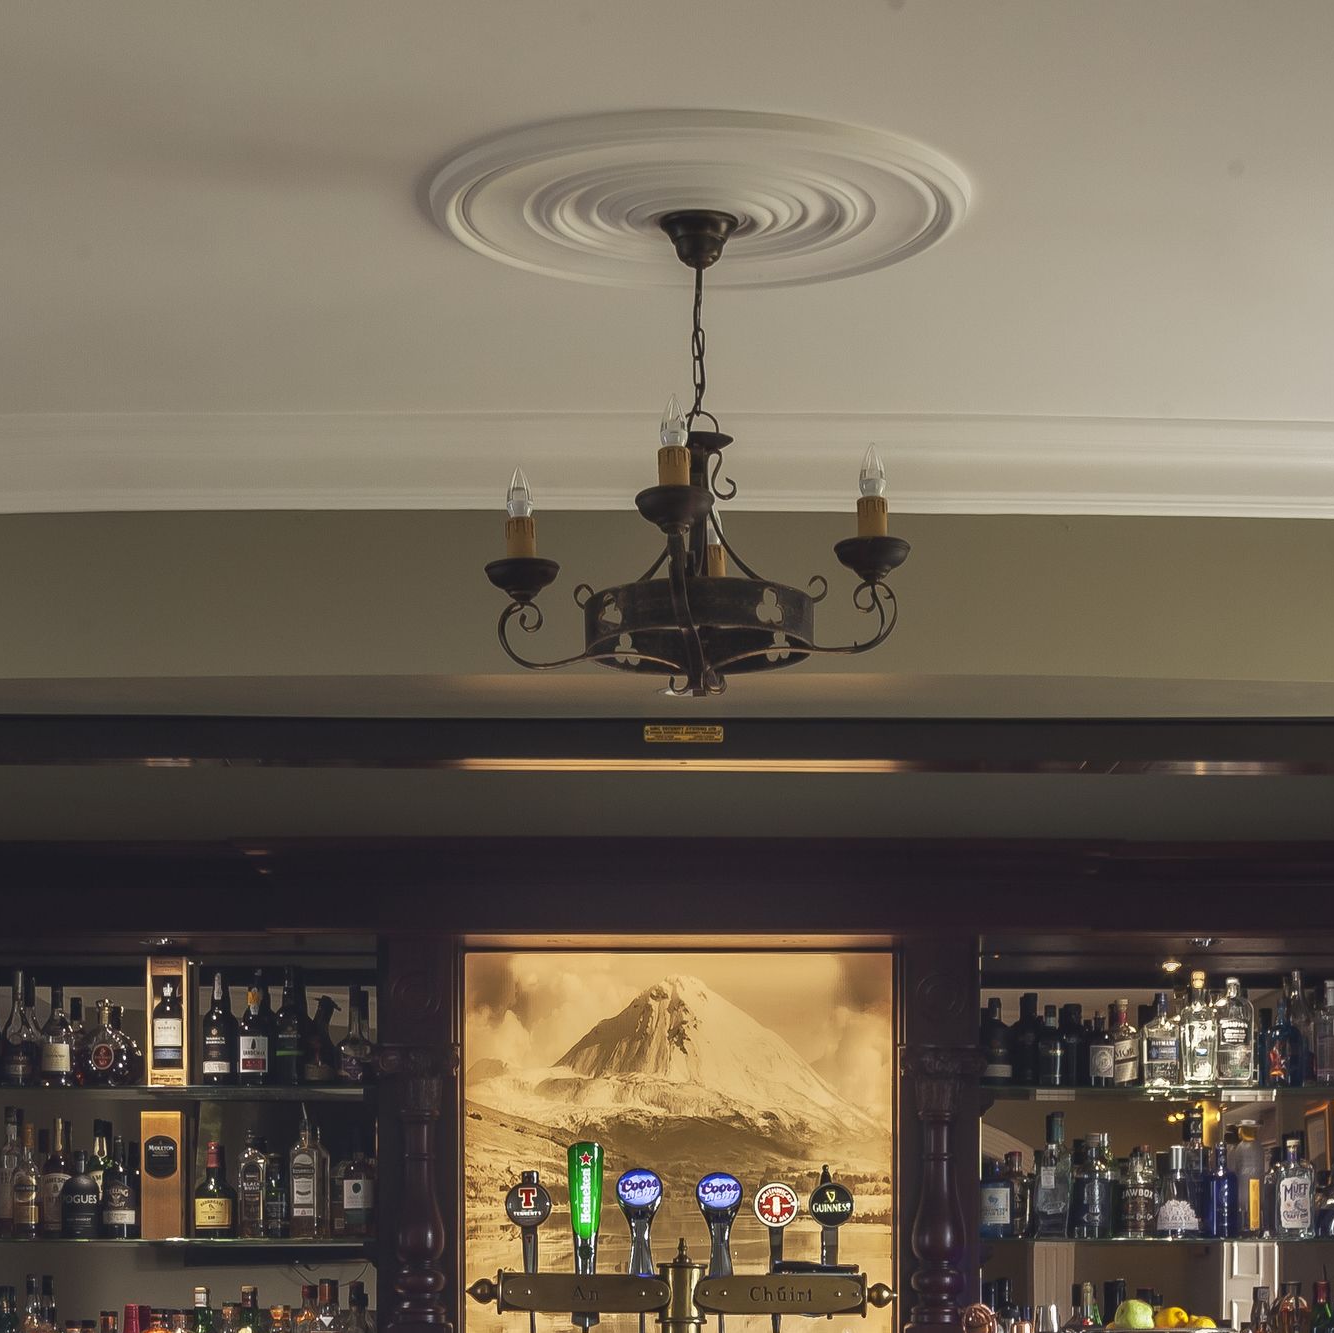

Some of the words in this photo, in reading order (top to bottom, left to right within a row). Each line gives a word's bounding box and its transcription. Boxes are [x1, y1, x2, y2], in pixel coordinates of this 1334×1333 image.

[620, 1179, 659, 1193] Coors
[701, 1182, 739, 1195] Coors
[581, 1168, 591, 1223] Heineken
[812, 1203, 850, 1212] GUINNESS
[764, 1213, 777, 1222] RED
[778, 1212, 789, 1221] ALE
[572, 1286, 599, 1301] An
